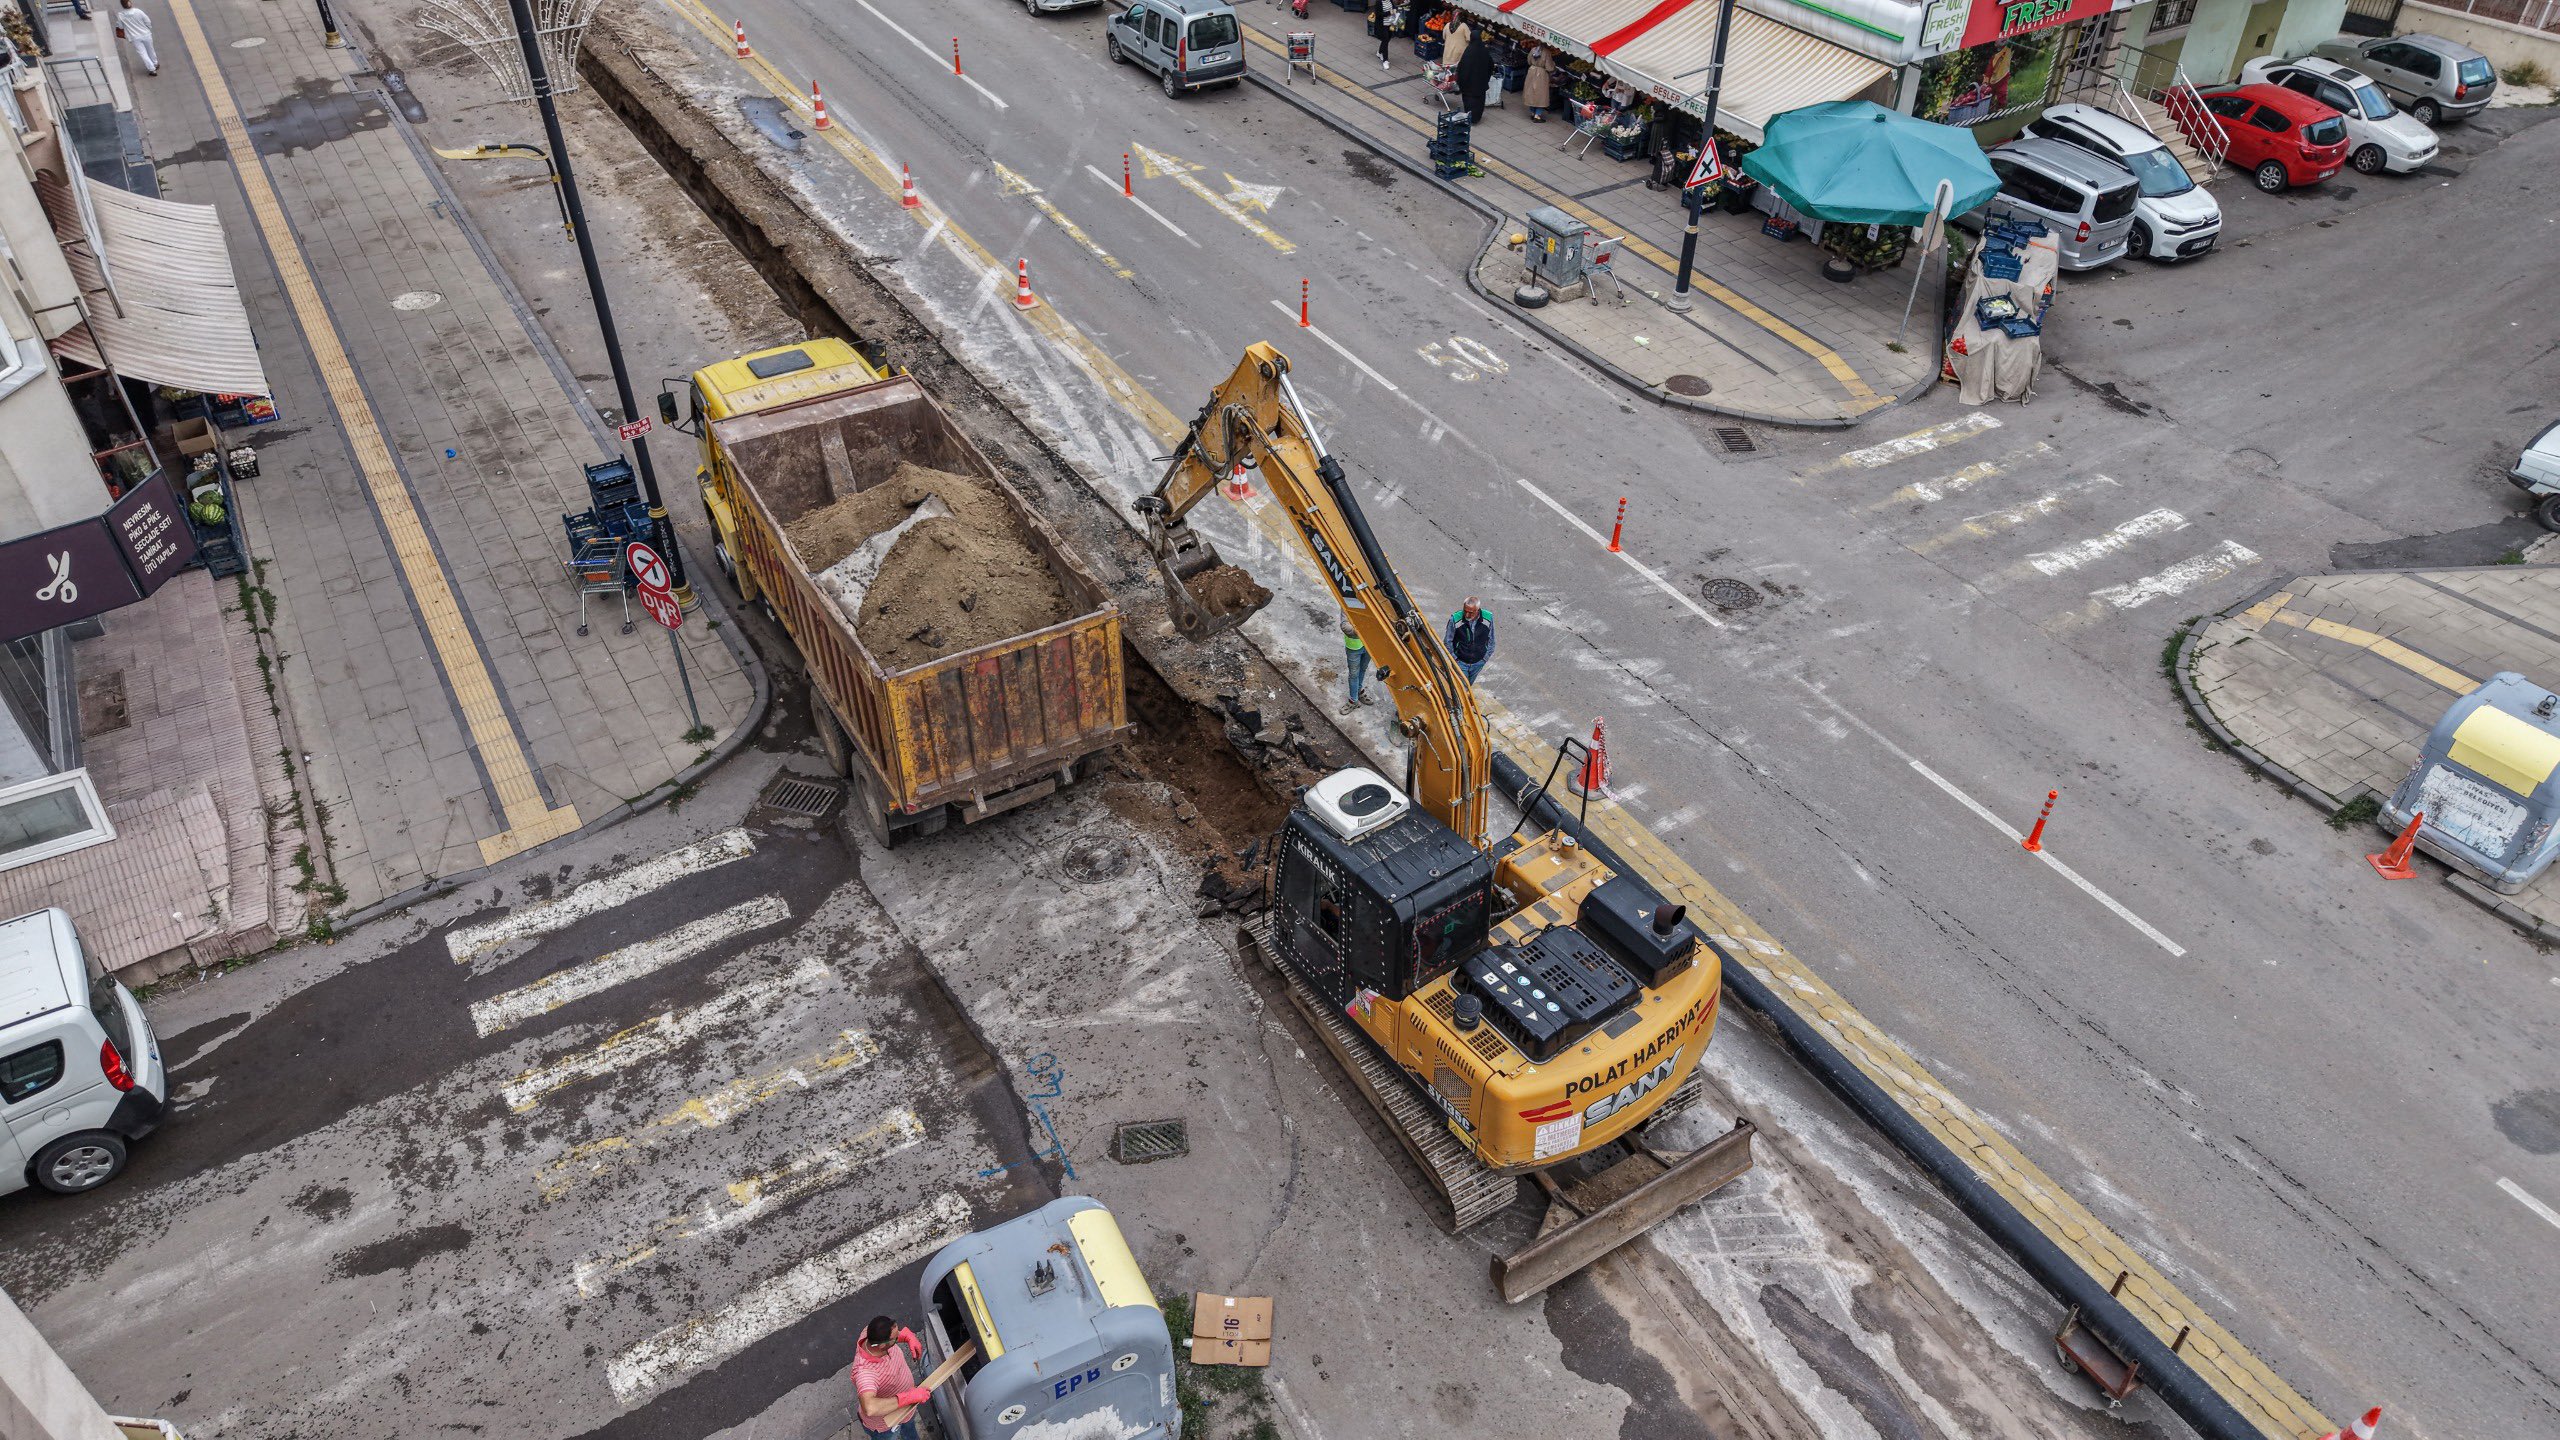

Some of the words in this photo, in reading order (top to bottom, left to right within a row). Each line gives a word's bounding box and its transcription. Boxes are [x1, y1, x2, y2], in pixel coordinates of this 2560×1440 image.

[1929, 12, 1965, 34] FRESH
[1548, 33, 1572, 50] FRESH
[122, 502, 153, 531] NEVRESİM
[128, 527, 143, 542] PİKO
[142, 521, 149, 531] &
[146, 510, 162, 526] PİKE
[134, 526, 161, 553] SECCADE
[159, 514, 173, 532] SETİ
[144, 559, 158, 575] ÜTÜ
[155, 542, 178, 565] YAPILIR
[1311, 532, 1353, 593] SANY
[642, 591, 680, 620] DUR
[1565, 1058, 1628, 1099] POLAT
[1583, 1042, 1686, 1130] SANY
[1427, 1083, 1471, 1131] SY135C
[1223, 1318, 1240, 1331] 16
